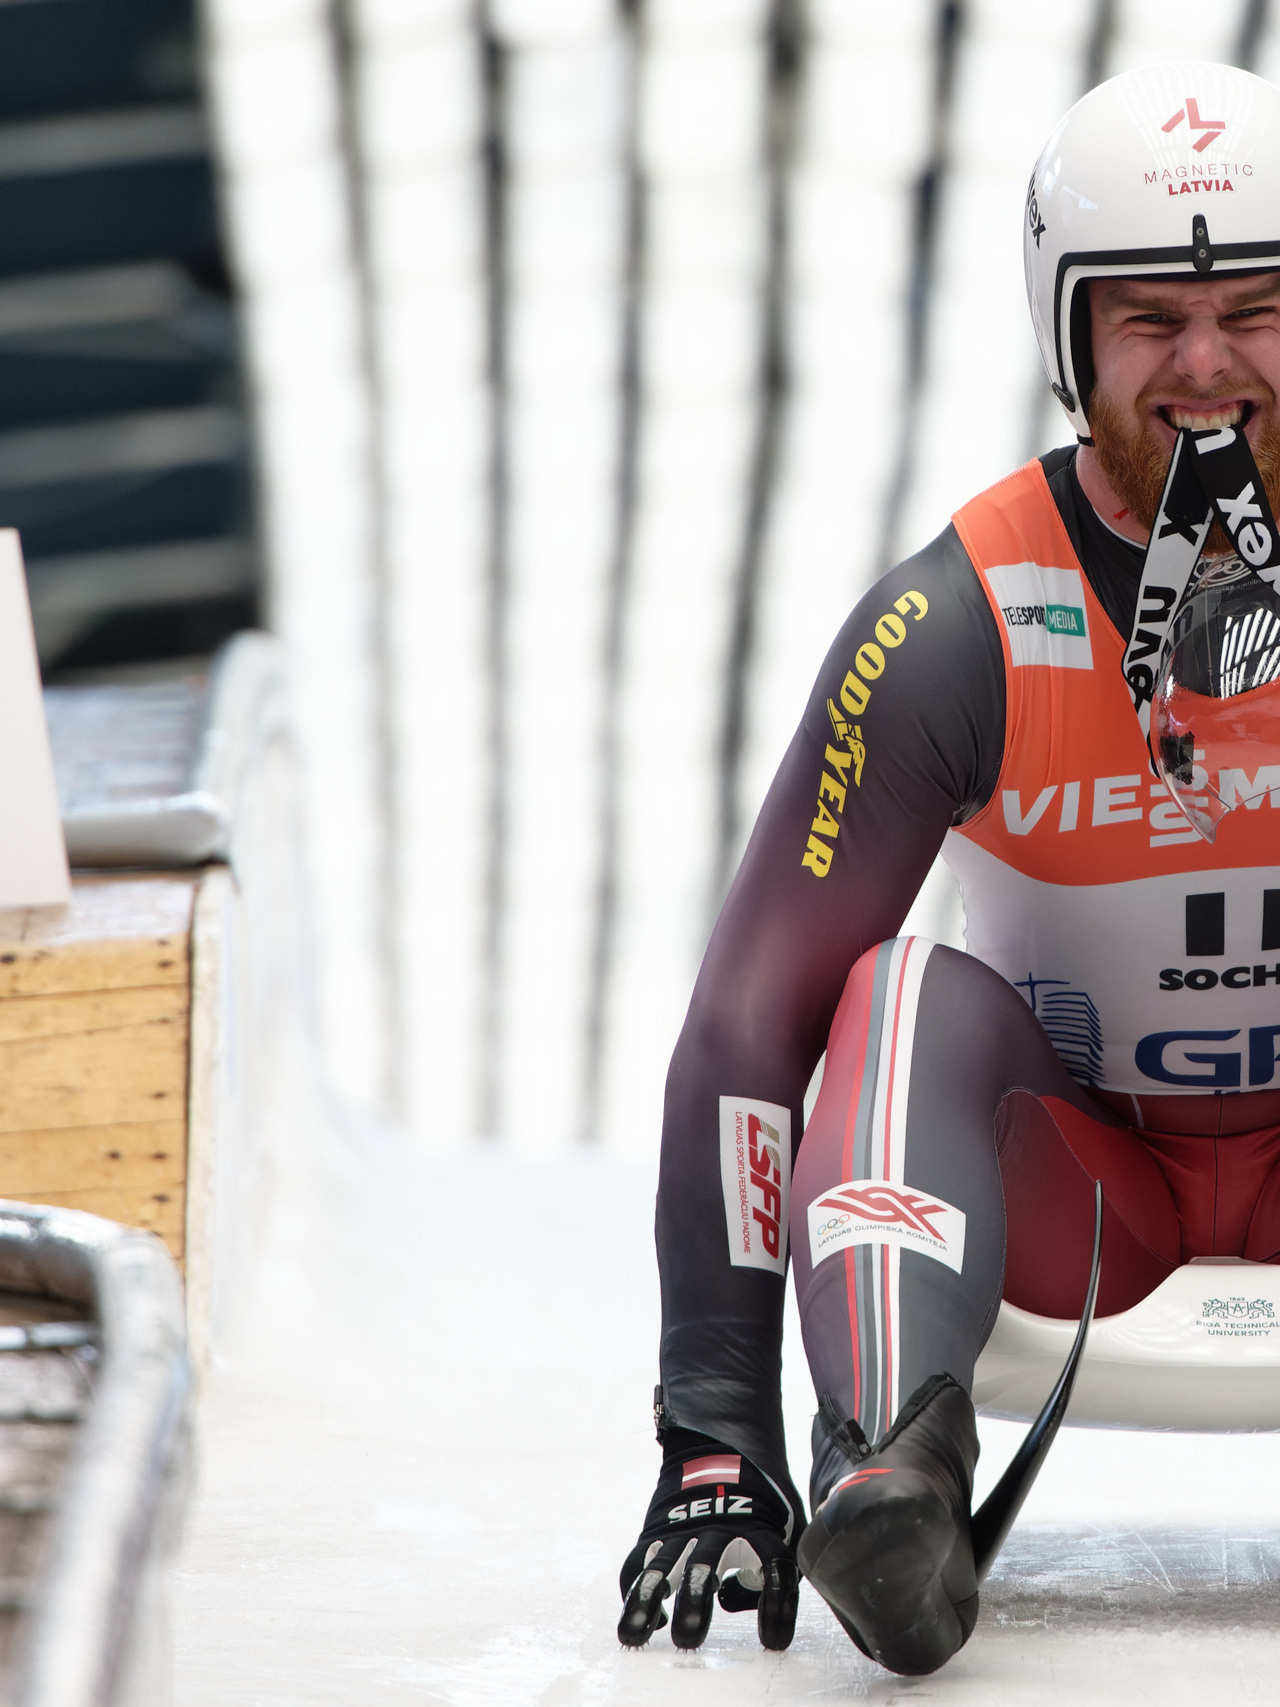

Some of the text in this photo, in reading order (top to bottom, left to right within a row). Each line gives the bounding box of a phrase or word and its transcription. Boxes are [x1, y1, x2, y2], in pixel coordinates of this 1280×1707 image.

[1144, 163, 1254, 185] MAGNETIC
[1167, 179, 1234, 196] LATVIA
[1048, 610, 1078, 631] MEDIA
[801, 590, 929, 878] GOODYEAR
[747, 1113, 782, 1260] LSFP
[736, 1144, 745, 1175] SPORTA
[743, 1221, 751, 1254] PADOME
[818, 1228, 852, 1248] LATVIJAS
[906, 1230, 948, 1252] KOMITEJA
[1207, 1329, 1270, 1337] UNIVERSITY
